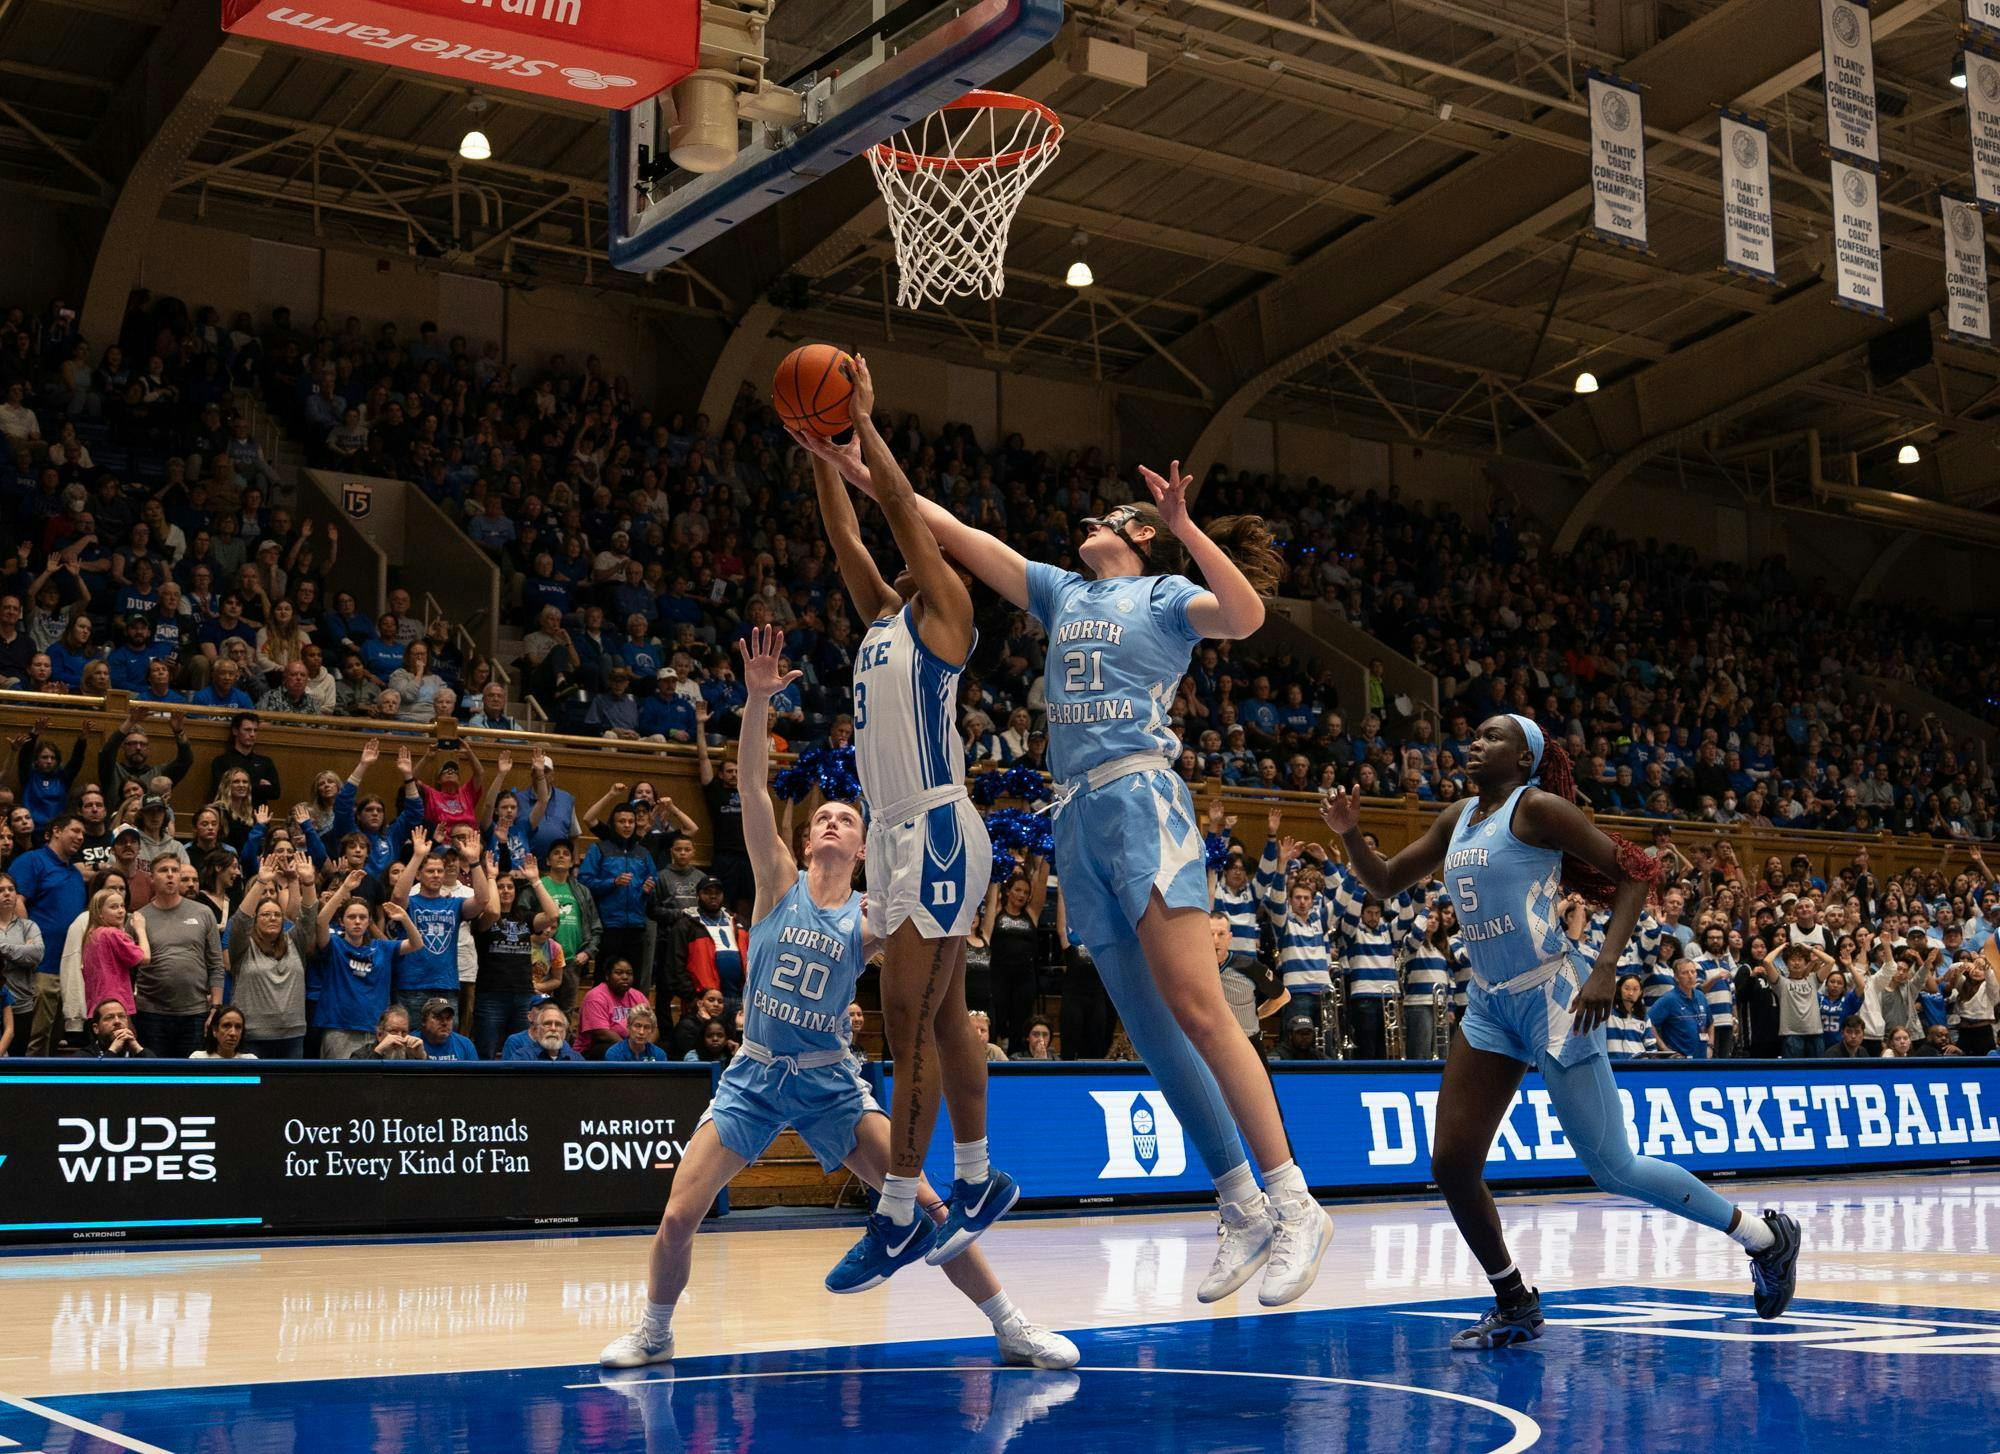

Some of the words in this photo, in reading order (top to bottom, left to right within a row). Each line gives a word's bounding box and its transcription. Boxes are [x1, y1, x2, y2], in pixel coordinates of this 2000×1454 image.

[1833, 54, 1865, 76] ATLANTIC
[1838, 71, 1862, 88] COAST
[1828, 81, 1875, 108] CONFERENCE
[1831, 97, 1874, 122] CHAMPIONS
[1601, 139, 1636, 160] ATLANTIC
[1845, 133, 1865, 149] 1964
[1607, 155, 1631, 171] COAST
[1594, 165, 1643, 190] CONFERENCE
[1731, 178, 1763, 197] ATLANTIC
[1597, 180, 1641, 203] CHAMPIONS
[1737, 192, 1759, 208] COAST
[1726, 202, 1771, 225] CONFERENCE
[1842, 213, 1872, 233] ATLANTIC
[1728, 216, 1770, 238] CHAMPIONS
[1848, 228, 1869, 243] COAST
[1837, 238, 1880, 260] CONFERENCE
[1840, 251, 1879, 272] CHAMPIONS
[1852, 282, 1871, 297] 2004
[348, 493, 368, 512] 15
[126, 597, 158, 611] DUK
[1056, 620, 1124, 646] NORTH
[1063, 650, 1104, 692] 21
[1048, 699, 1134, 724] CAROLINA
[1445, 848, 1488, 872] NORTH
[1457, 876, 1478, 913] 5
[779, 926, 845, 962] NORTH
[771, 952, 831, 1001] 20
[754, 989, 837, 1033] CAROLINA
[58, 1117, 216, 1153] DUDE
[284, 1118, 342, 1145] Over
[349, 1119, 375, 1144] 30
[382, 1118, 445, 1143] Hotel
[451, 1118, 529, 1143] Brands
[580, 1119, 676, 1136] MARRIOTT
[285, 1151, 319, 1177] for
[326, 1151, 393, 1181] Every
[399, 1150, 456, 1175] Kind
[462, 1149, 486, 1173] of
[490, 1149, 530, 1173] Fan
[534, 1216, 579, 1224] DAKTRONICS
[73, 1231, 127, 1239] DAKTRONICS
